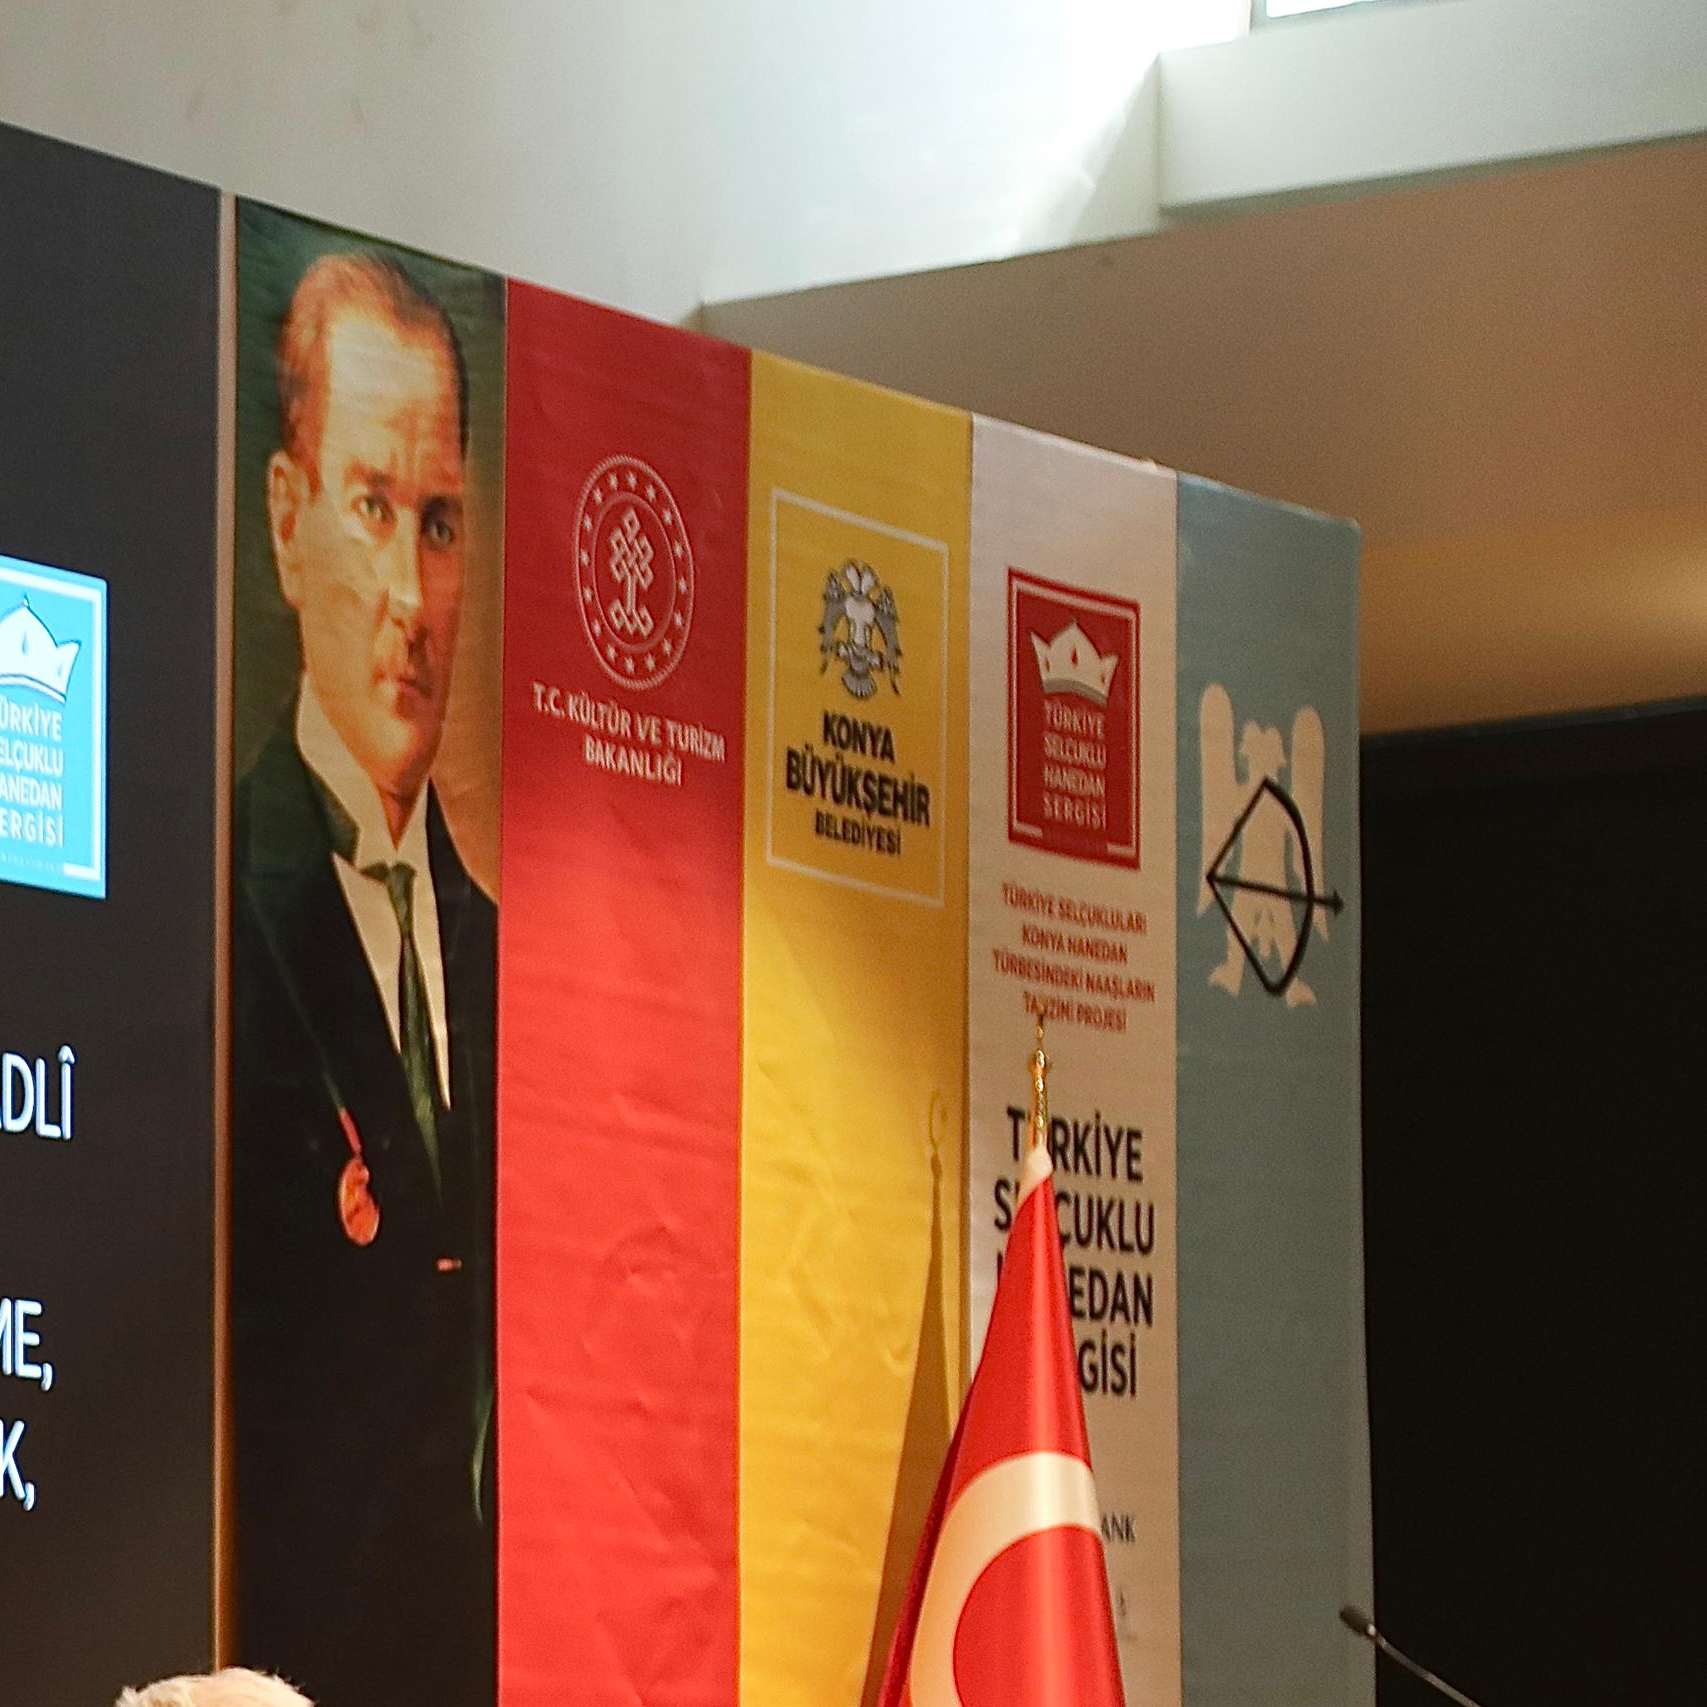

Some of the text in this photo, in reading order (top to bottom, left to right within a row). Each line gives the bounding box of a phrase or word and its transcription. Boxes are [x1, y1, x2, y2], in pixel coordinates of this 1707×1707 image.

[533, 681, 726, 762] T.C. KÜLTÜR VE TURİZM
[823, 710, 895, 764] KONYA
[585, 734, 682, 785] BAKANLIĞI
[786, 743, 930, 827] BÜYÜKŞEHİR
[815, 809, 901, 856] BELEDİYESİ
[1007, 1105, 1143, 1183] TRKİYE
[994, 1178, 1154, 1256] SUKLU
[1078, 1328, 1136, 1397] GİSİ
